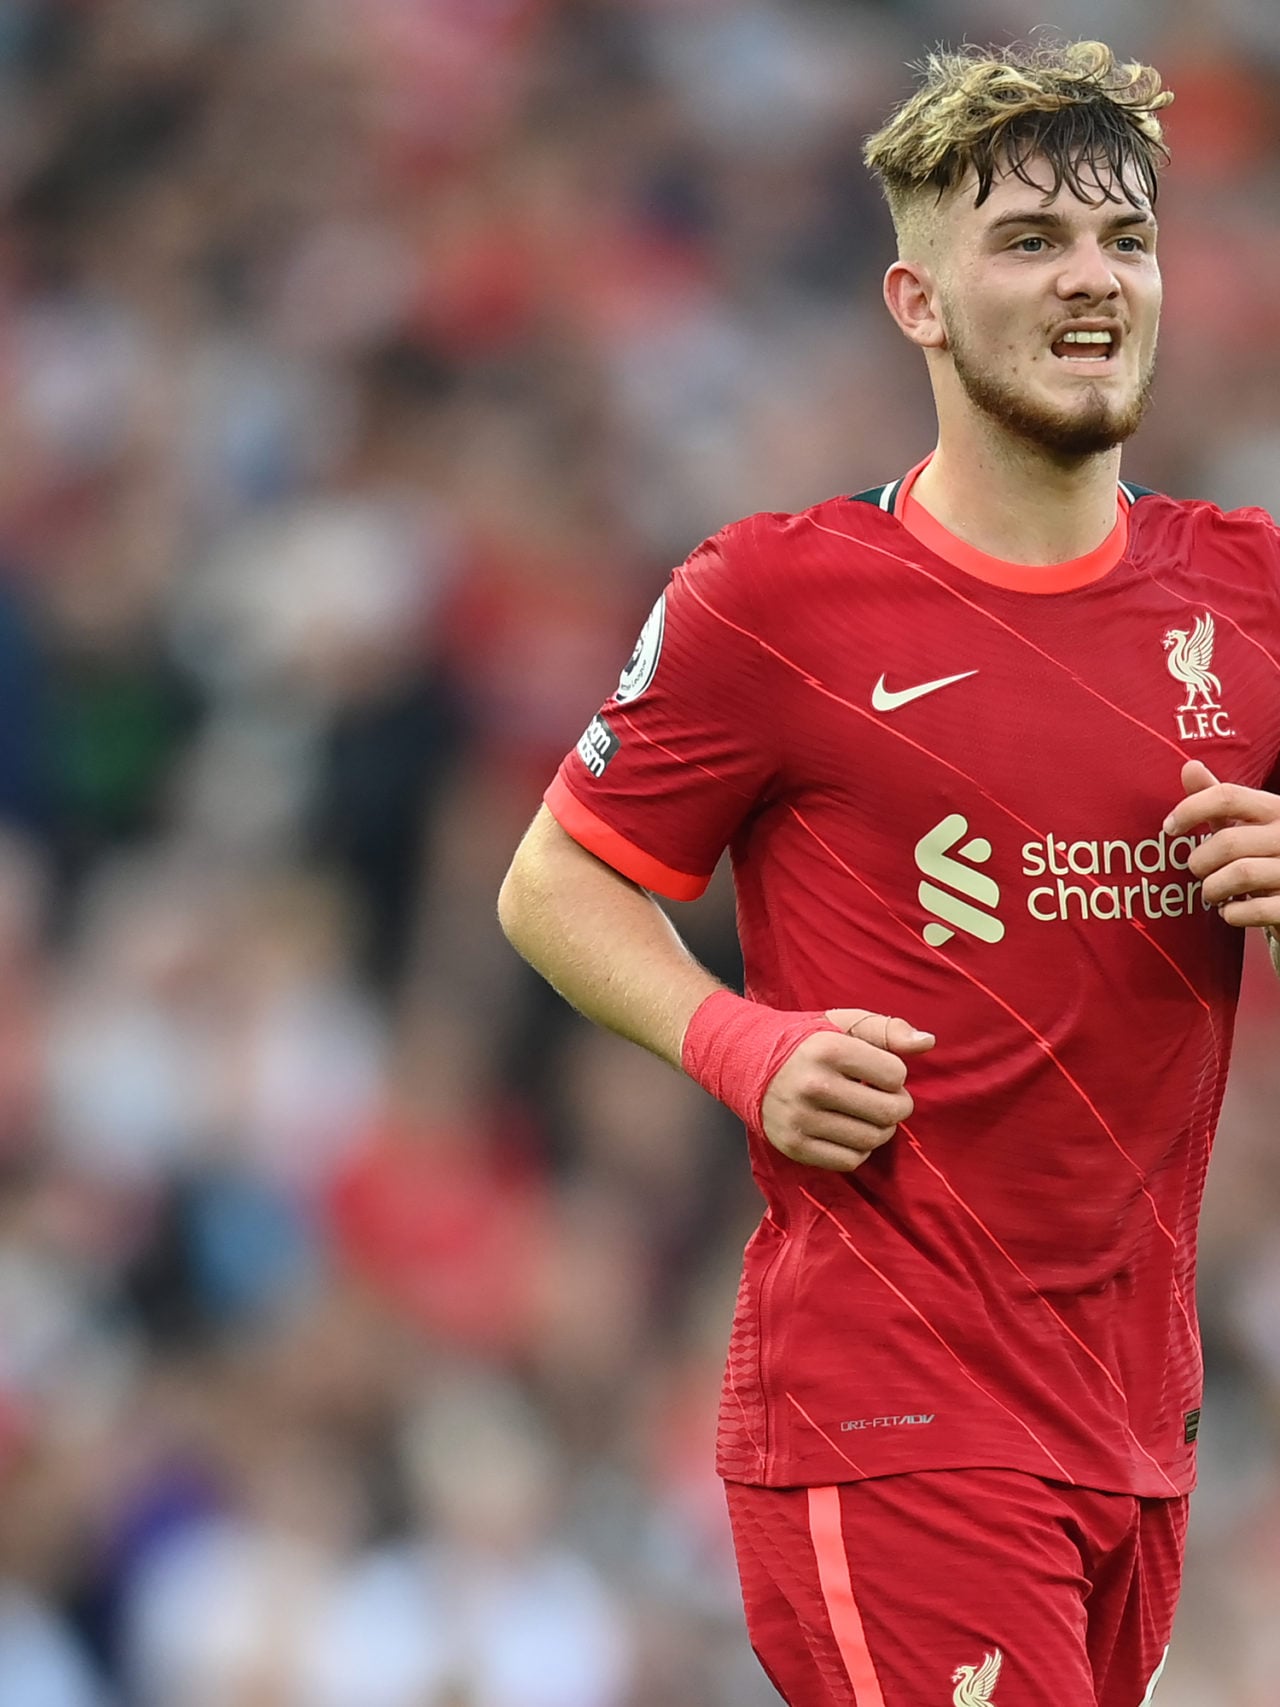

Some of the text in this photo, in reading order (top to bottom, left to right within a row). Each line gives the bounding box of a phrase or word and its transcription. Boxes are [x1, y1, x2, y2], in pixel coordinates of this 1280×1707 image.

[1176, 711, 1236, 739] L.F.C.
[1021, 832, 1213, 876] standa
[1027, 877, 1233, 921] charter
